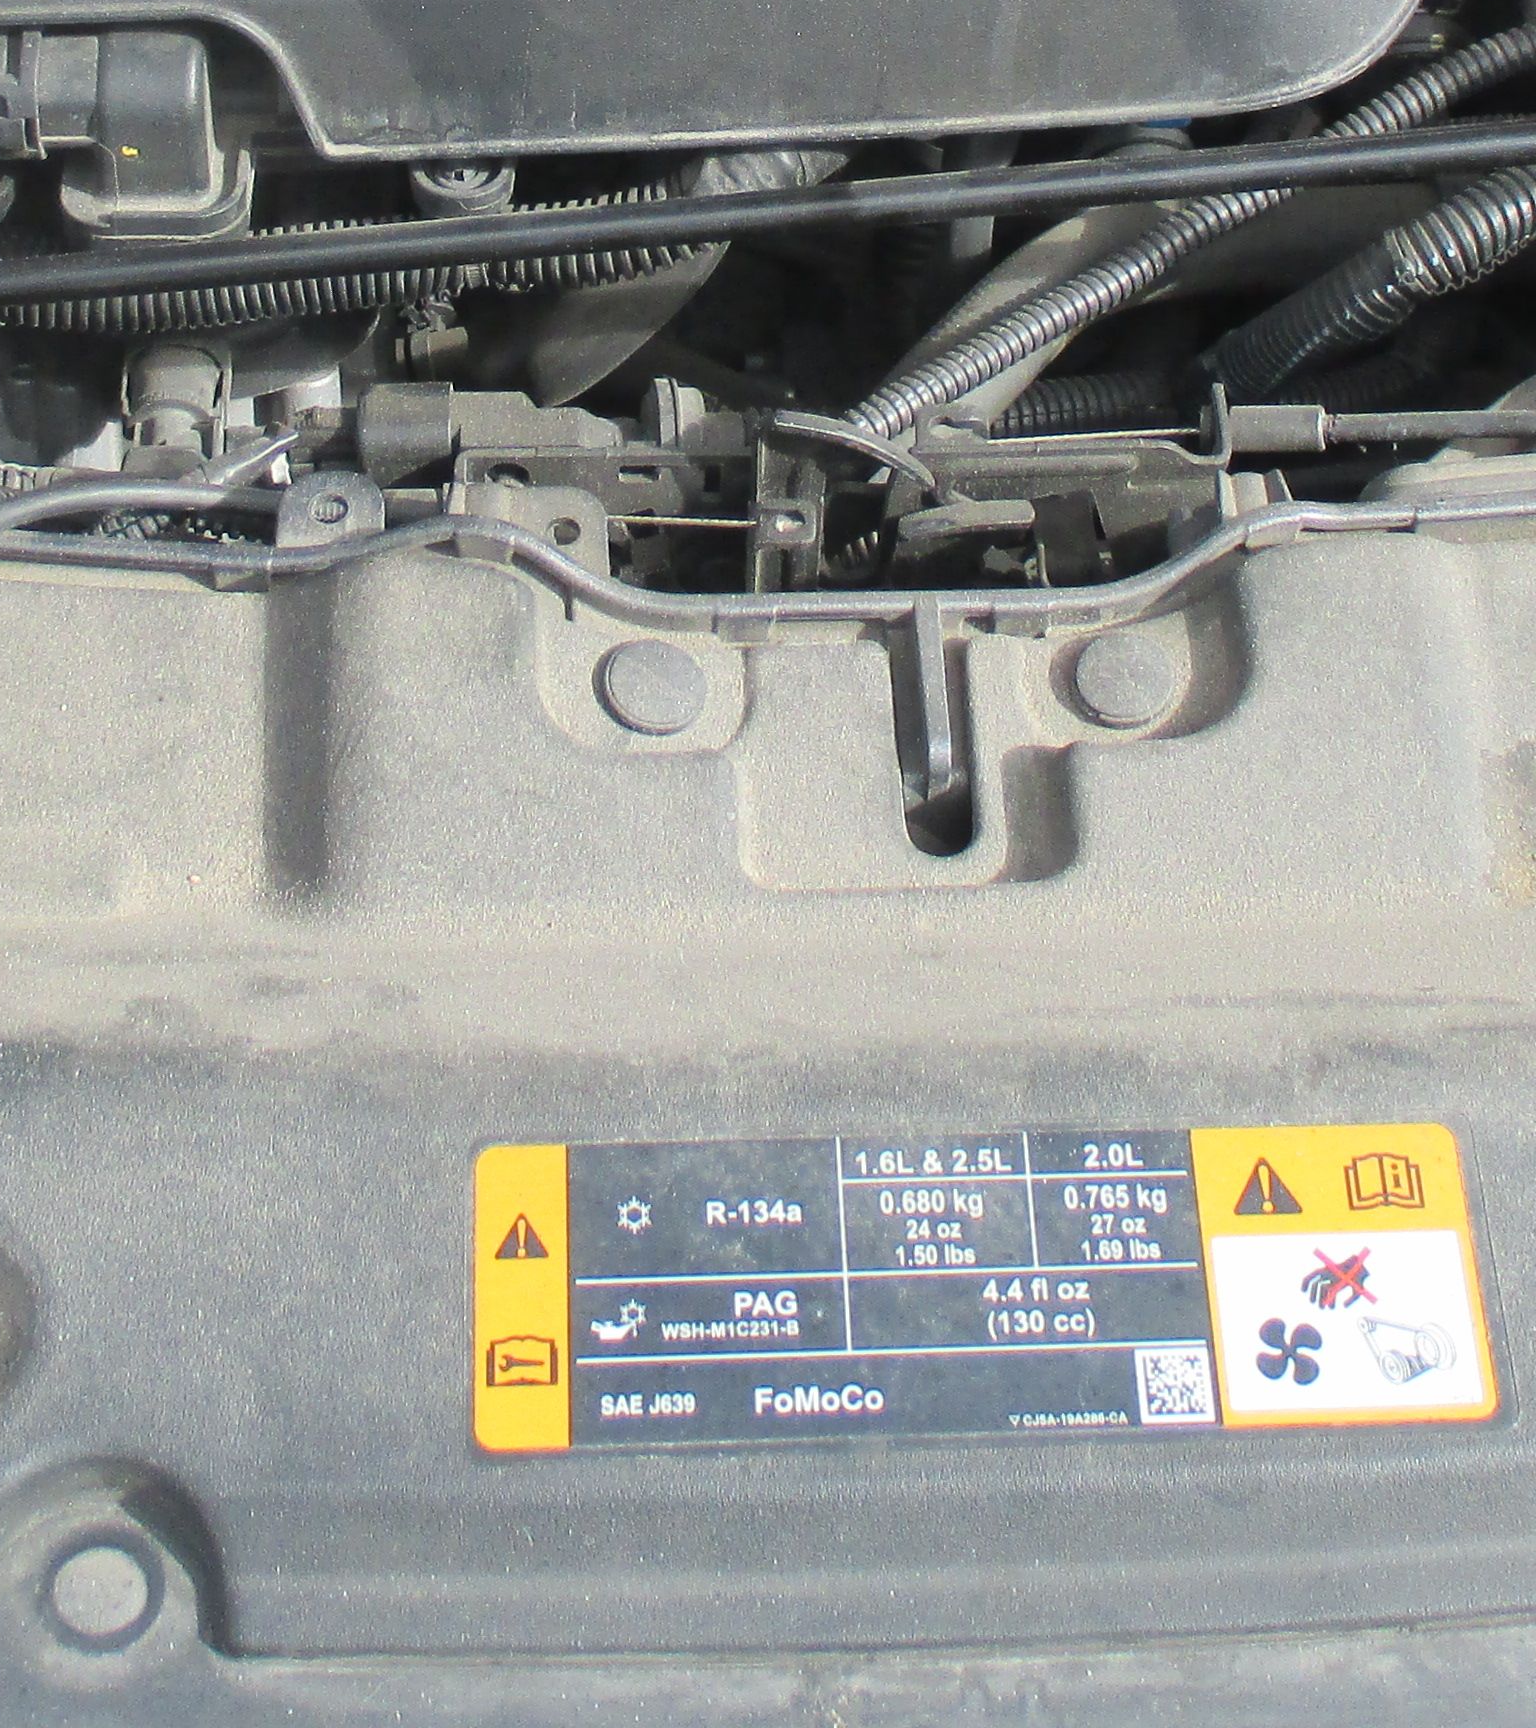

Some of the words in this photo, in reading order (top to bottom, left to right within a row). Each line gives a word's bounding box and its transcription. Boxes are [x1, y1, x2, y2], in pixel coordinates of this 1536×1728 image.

[855, 1150, 914, 1175] 1.6L
[923, 1149, 943, 1174] &
[952, 1148, 1012, 1173] 2.5L
[1084, 1143, 1144, 1167] 2.0L
[880, 1189, 945, 1214] 0.680
[953, 1188, 984, 1218] kg
[1064, 1184, 1130, 1209] 0.765
[1136, 1183, 1167, 1213] kg
[706, 1199, 802, 1224] R-134a
[1090, 1213, 1114, 1235] 27
[1121, 1217, 1147, 1233] oz
[906, 1219, 931, 1240] 24
[937, 1222, 962, 1239] oz
[895, 1244, 938, 1266] 1.50
[944, 1243, 976, 1265] lbs
[1081, 1239, 1124, 1261] 1.69
[1129, 1238, 1161, 1260] lbs
[983, 1276, 1024, 1302] 4.4
[1030, 1276, 1049, 1301] fl
[1057, 1281, 1091, 1300] oz
[734, 1290, 798, 1317] PAG
[987, 1309, 1045, 1342] (130
[1053, 1307, 1096, 1339] cc)
[600, 1394, 644, 1416] SAE
[649, 1392, 696, 1415] J639
[754, 1384, 884, 1414] FoMoCo
